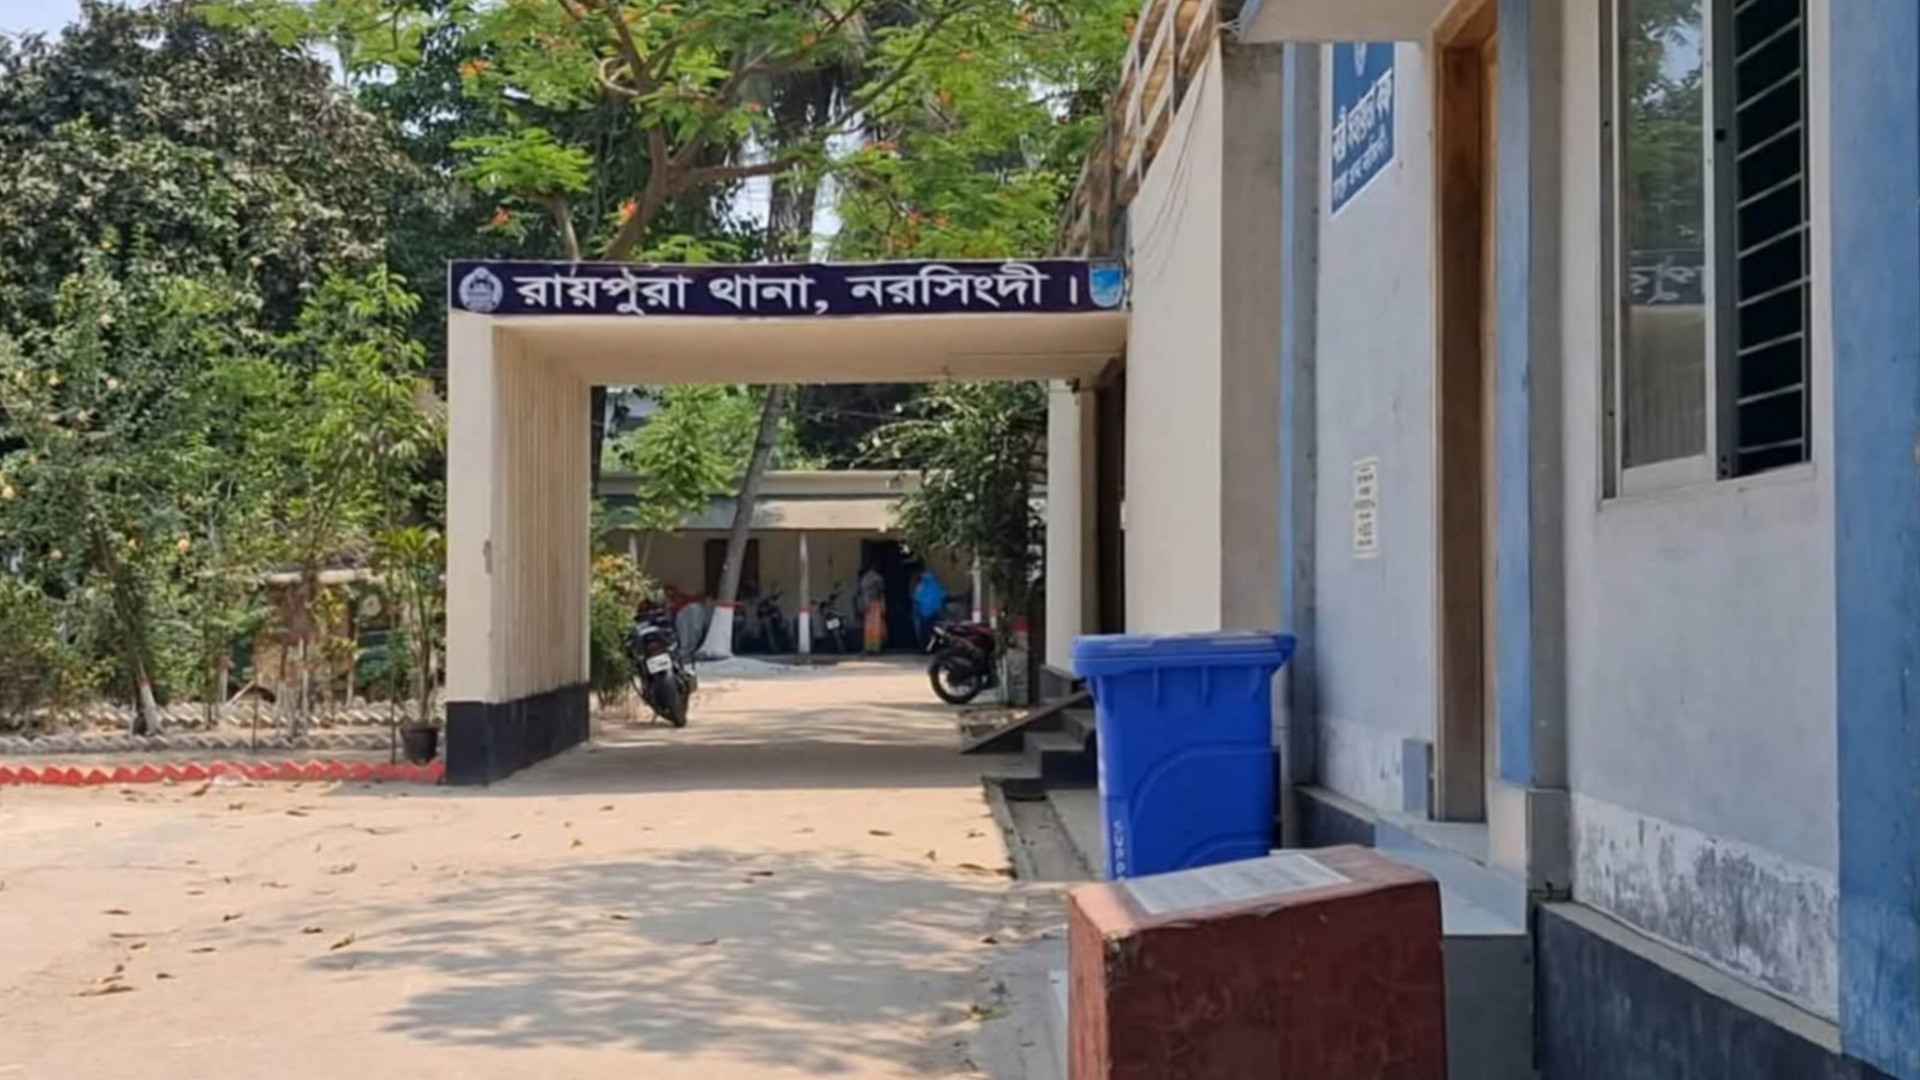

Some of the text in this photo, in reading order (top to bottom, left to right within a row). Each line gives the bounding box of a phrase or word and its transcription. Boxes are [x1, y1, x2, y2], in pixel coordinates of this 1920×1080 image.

[513, 272, 694, 316] রায়পুরা
[708, 274, 829, 315] থানা,
[845, 263, 1050, 308] নরসিংদী
